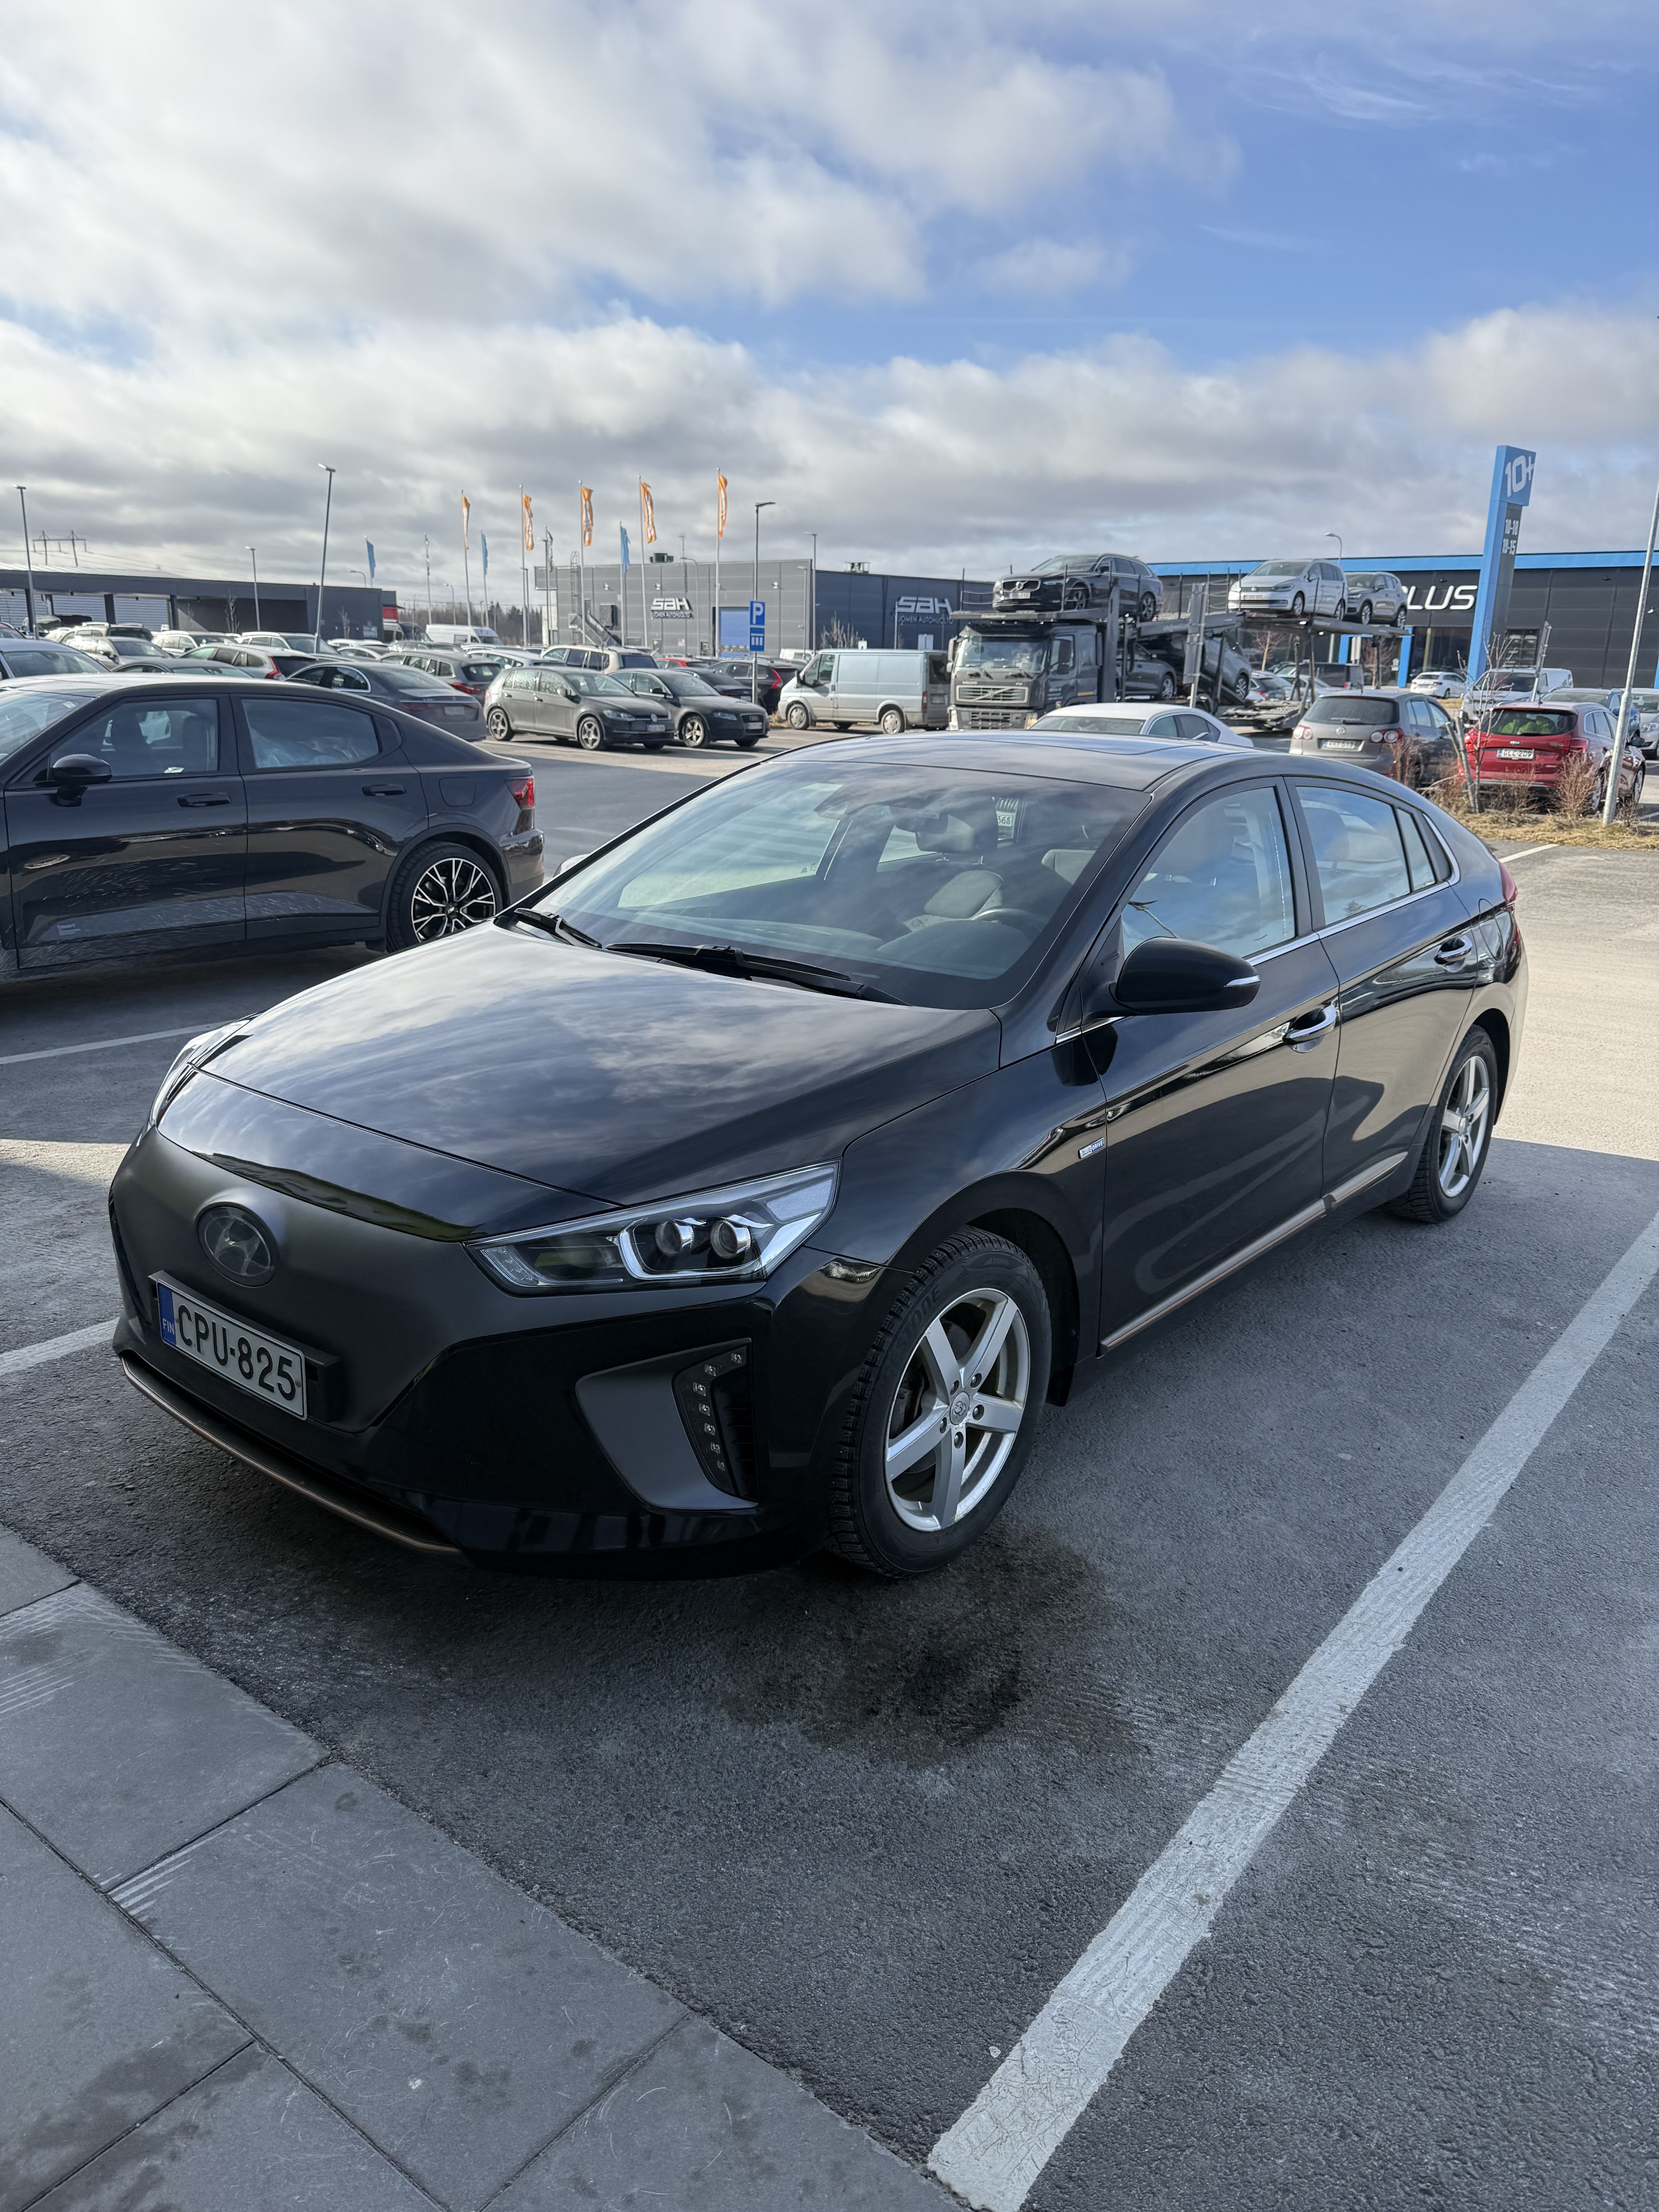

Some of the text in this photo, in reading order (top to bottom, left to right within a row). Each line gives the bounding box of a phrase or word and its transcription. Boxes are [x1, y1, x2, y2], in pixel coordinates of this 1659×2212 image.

[1505, 455, 1534, 497] 10+
[753, 603, 763, 624] P
[163, 1318, 175, 1335] FIN
[178, 1305, 296, 1401] CPU-825
